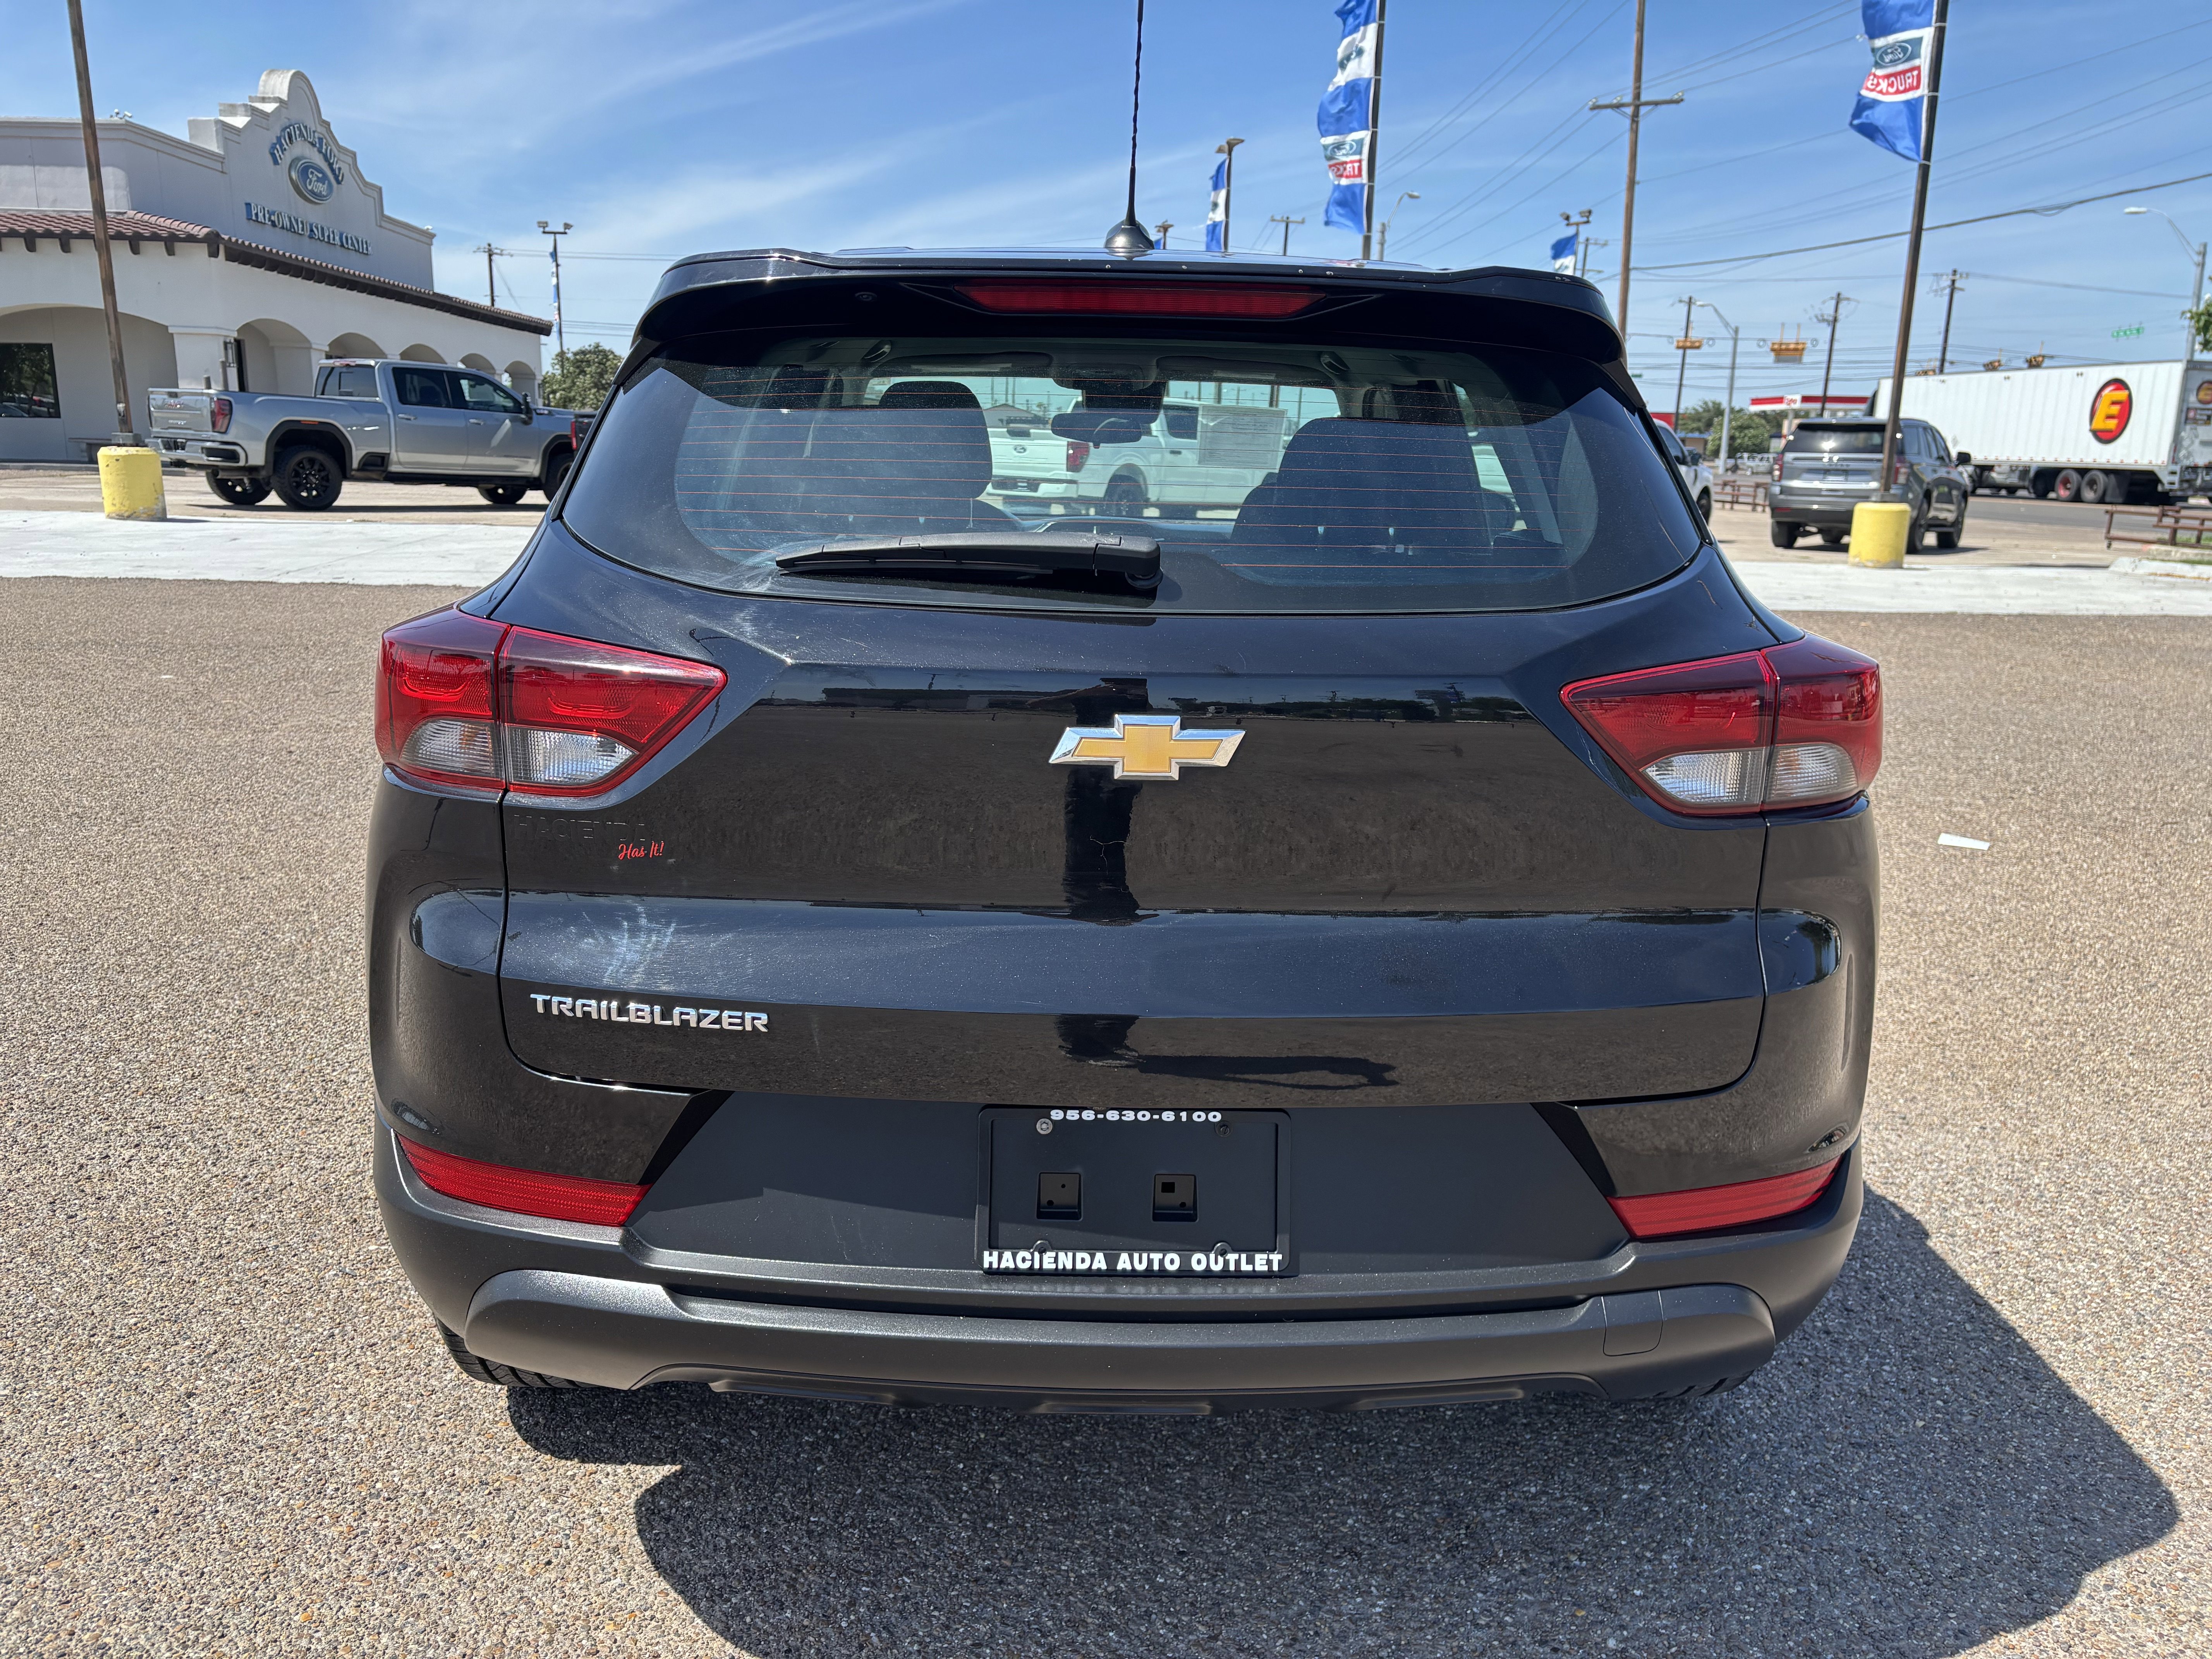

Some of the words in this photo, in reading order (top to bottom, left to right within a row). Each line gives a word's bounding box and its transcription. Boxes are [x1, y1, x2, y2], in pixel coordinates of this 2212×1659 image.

[272, 123, 319, 165] HACIENDA
[306, 168, 328, 196] Ford
[250, 203, 310, 236] PRE-OWNED
[312, 222, 340, 246] SUPER
[342, 232, 373, 255] CENTER
[2089, 390, 2130, 433] E
[514, 814, 652, 843] HACIENDA
[618, 843, 645, 860] Has
[649, 840, 665, 858] It!
[530, 993, 769, 1032] TRAILBLAZER
[1050, 1109, 1222, 1122] 956-630-6100
[983, 1250, 1107, 1269] HACIENDA
[1116, 1252, 1181, 1271] AUTO
[1191, 1253, 1283, 1271] OUTLET
